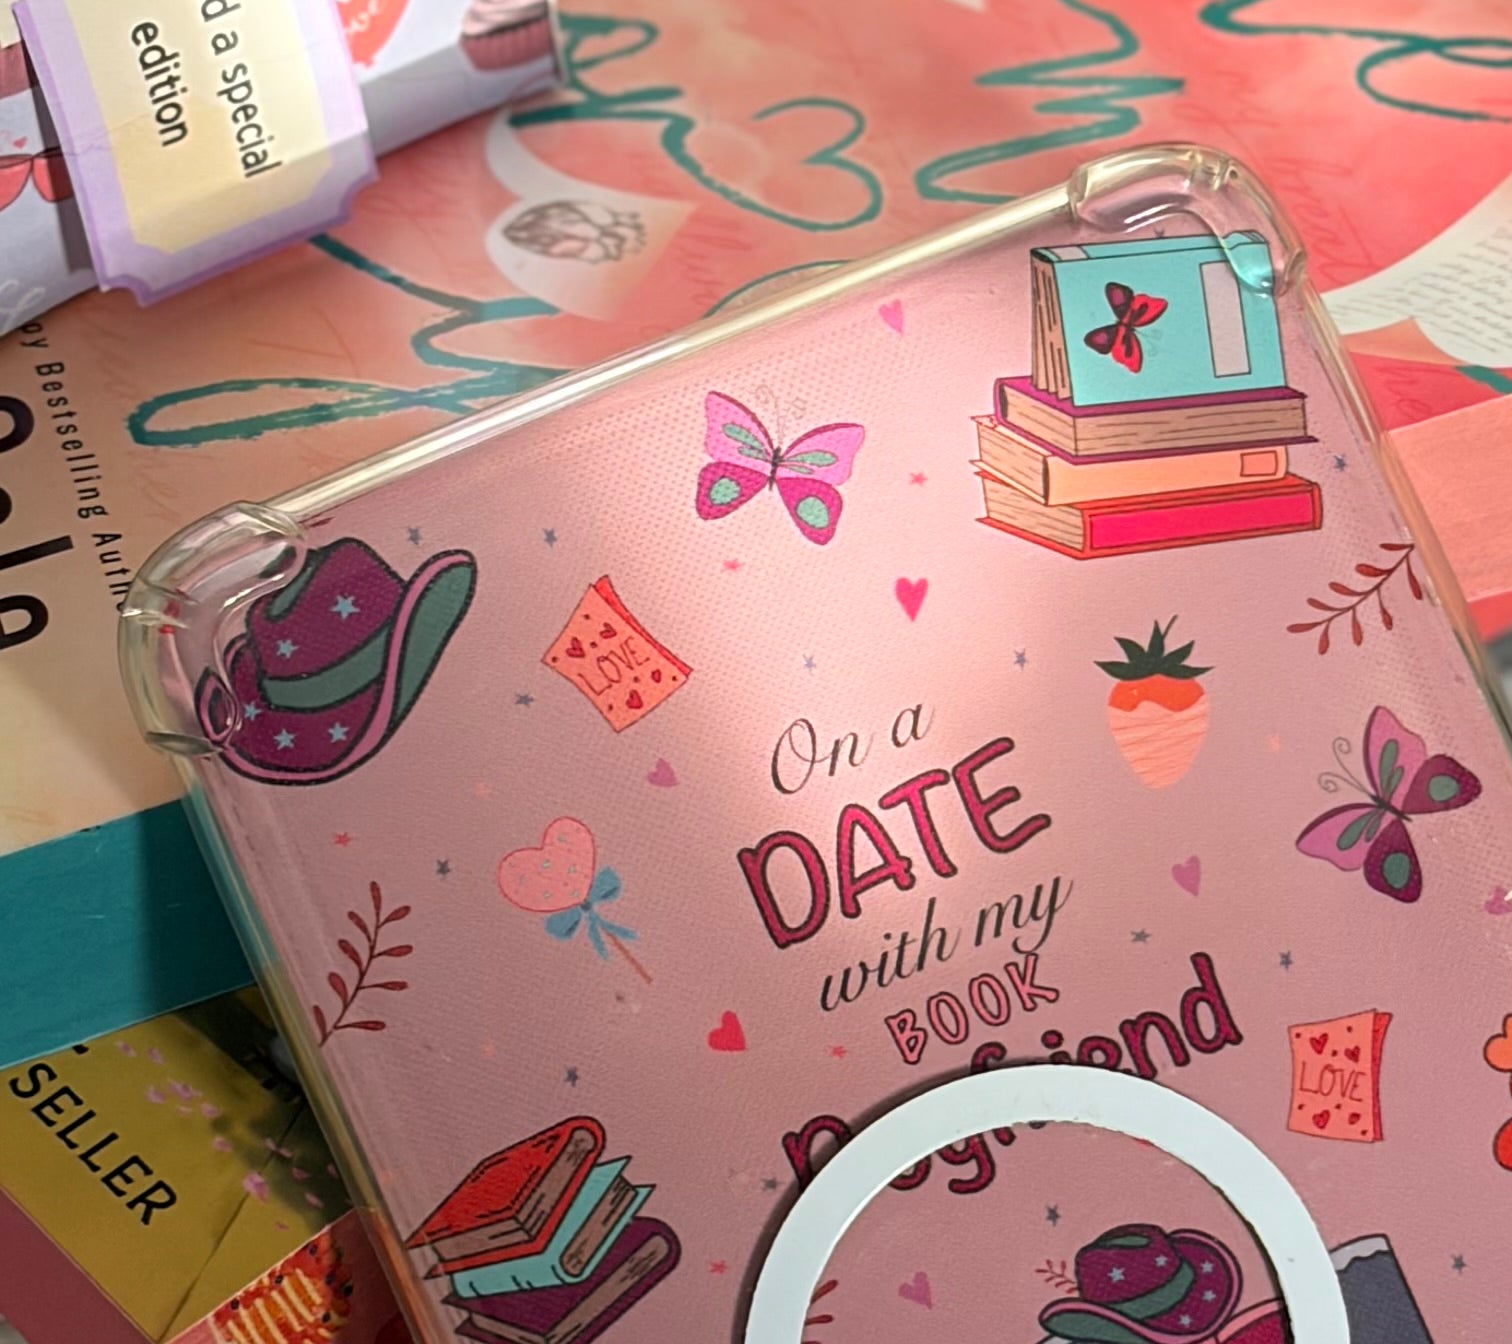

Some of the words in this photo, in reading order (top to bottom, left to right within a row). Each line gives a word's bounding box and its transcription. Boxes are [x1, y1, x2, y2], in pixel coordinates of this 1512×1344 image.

[131, 21, 189, 147] edition
[210, 30, 240, 56] a
[216, 62, 283, 178] special
[35, 360, 110, 519] Bestselling
[577, 635, 651, 697] LOVE
[770, 717, 874, 795] On
[890, 703, 935, 749] a
[736, 736, 1052, 950] DATE
[819, 895, 962, 1012] with
[973, 875, 1074, 954] my
[883, 951, 1060, 1066] BOOK
[1298, 1060, 1367, 1103] LOVE
[8, 1062, 178, 1226] SELLER
